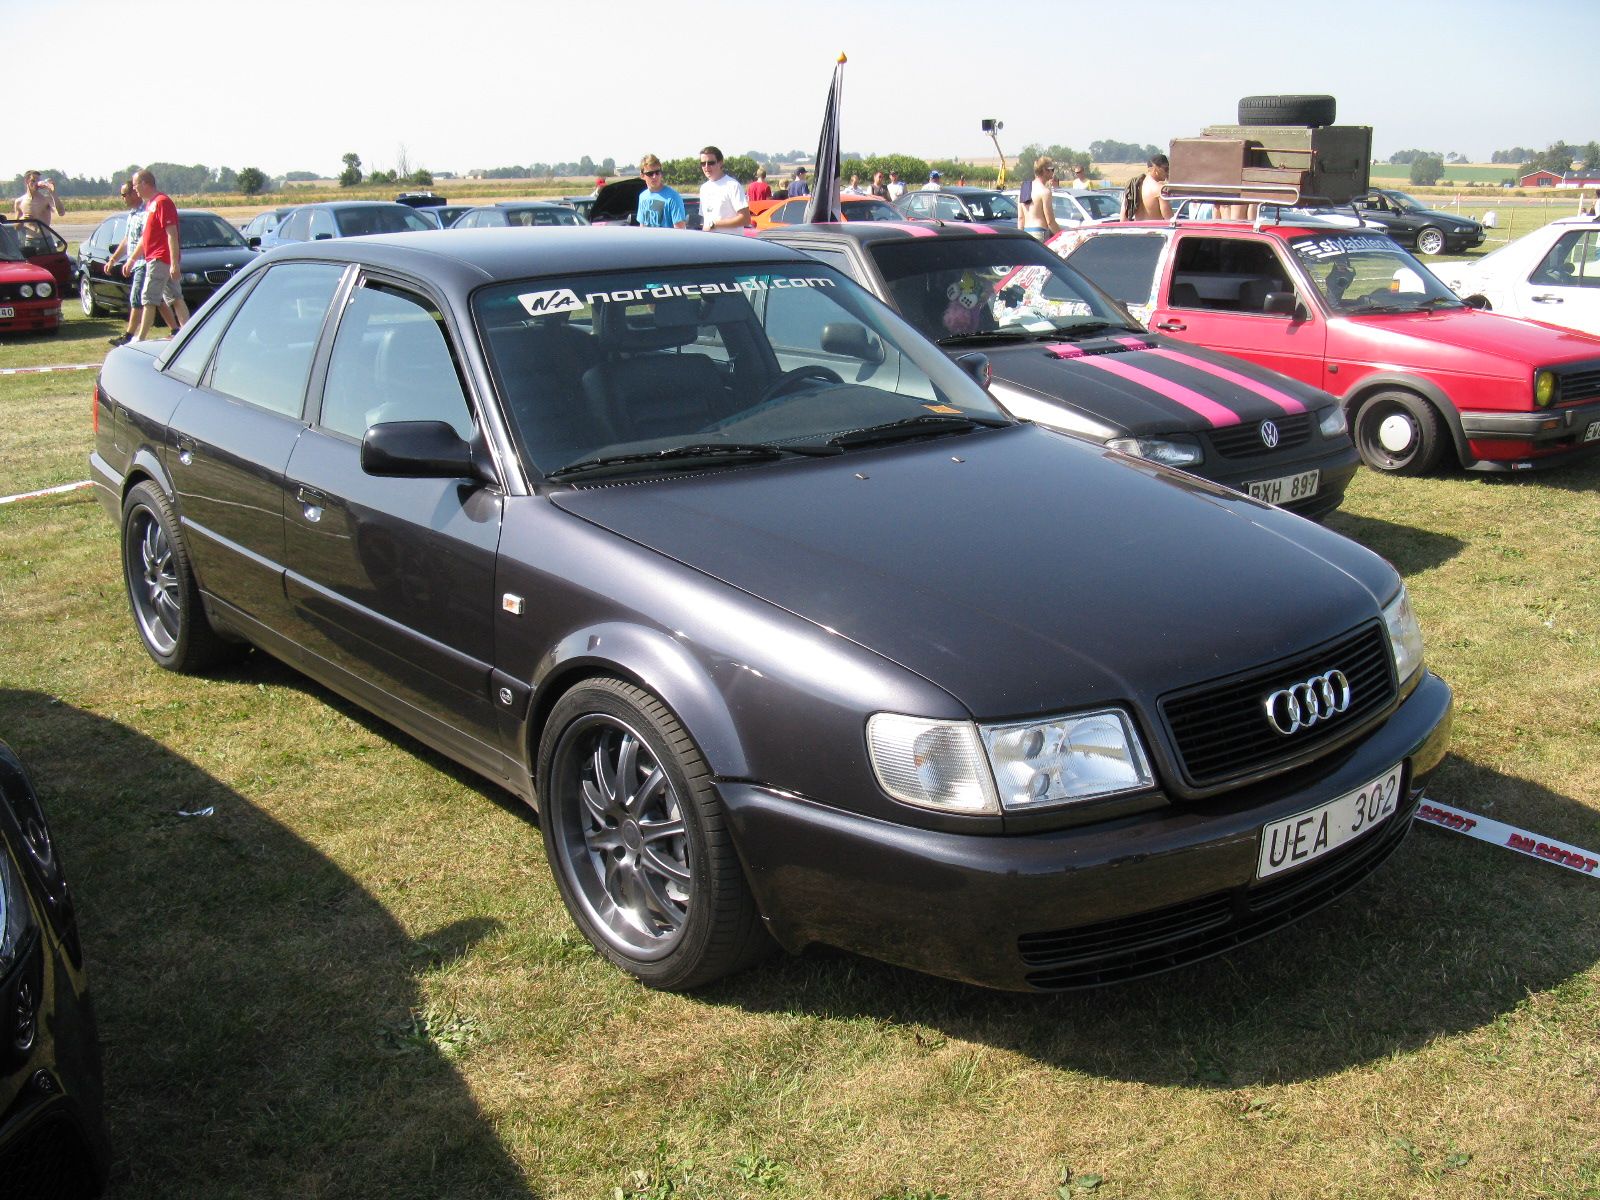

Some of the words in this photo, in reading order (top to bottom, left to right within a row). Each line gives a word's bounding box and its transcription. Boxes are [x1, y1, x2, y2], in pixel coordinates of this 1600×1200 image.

[585, 277, 836, 304] nordicaudi.com
[1291, 472, 1318, 498] 897
[1269, 810, 1328, 868] UEA
[1351, 774, 1396, 832] 302
